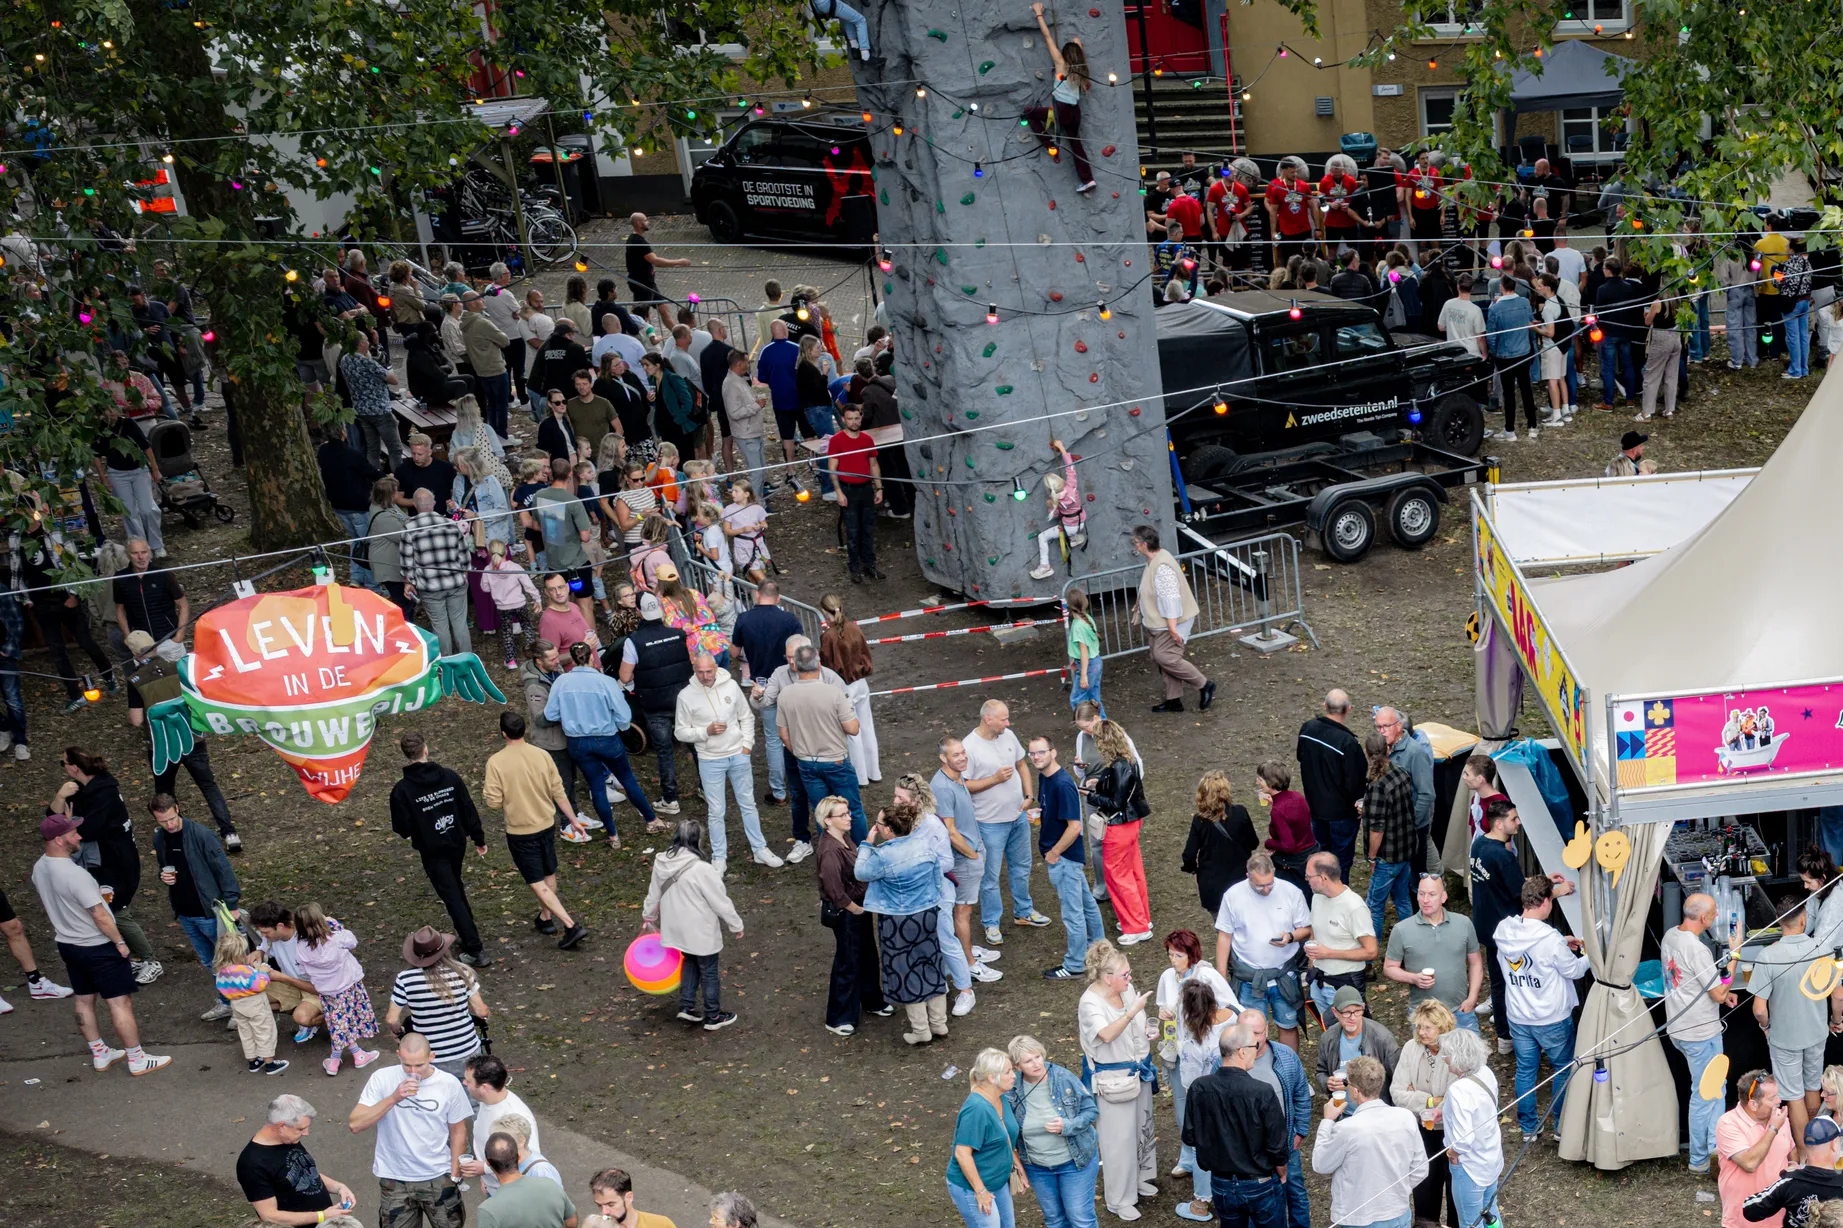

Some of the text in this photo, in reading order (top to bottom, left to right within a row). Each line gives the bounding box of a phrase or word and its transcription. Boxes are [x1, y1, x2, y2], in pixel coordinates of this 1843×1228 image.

[742, 181, 814, 196] DE GROOTSTE IN
[747, 195, 815, 209] SPORTVOEDING
[1301, 396, 1398, 426] zweedsetenten.nl
[283, 665, 352, 697] IN DE
[206, 687, 426, 749] BROUWERIJ
[303, 762, 362, 788] WIJHE
